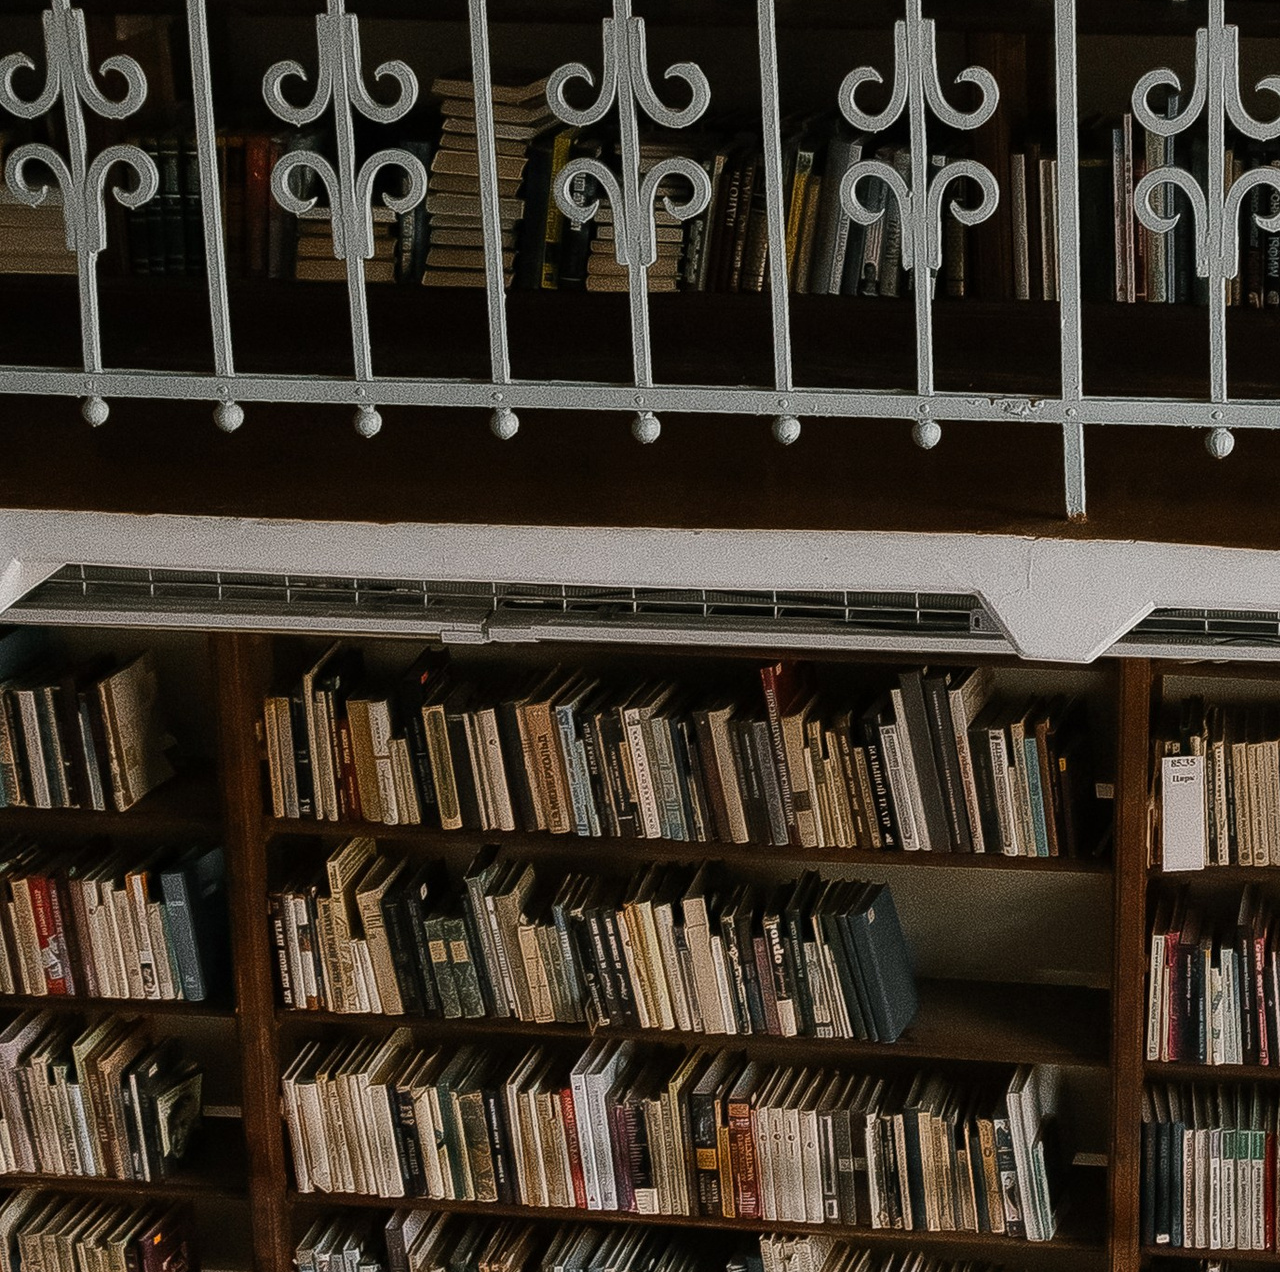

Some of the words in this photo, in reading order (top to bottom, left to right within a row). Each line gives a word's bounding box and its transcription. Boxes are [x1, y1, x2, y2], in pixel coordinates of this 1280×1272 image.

[868, 744, 887, 795] БОЛЬШОЙ
[1170, 758, 1196, 768] 85.35
[877, 797, 891, 827] ТЕАТР
